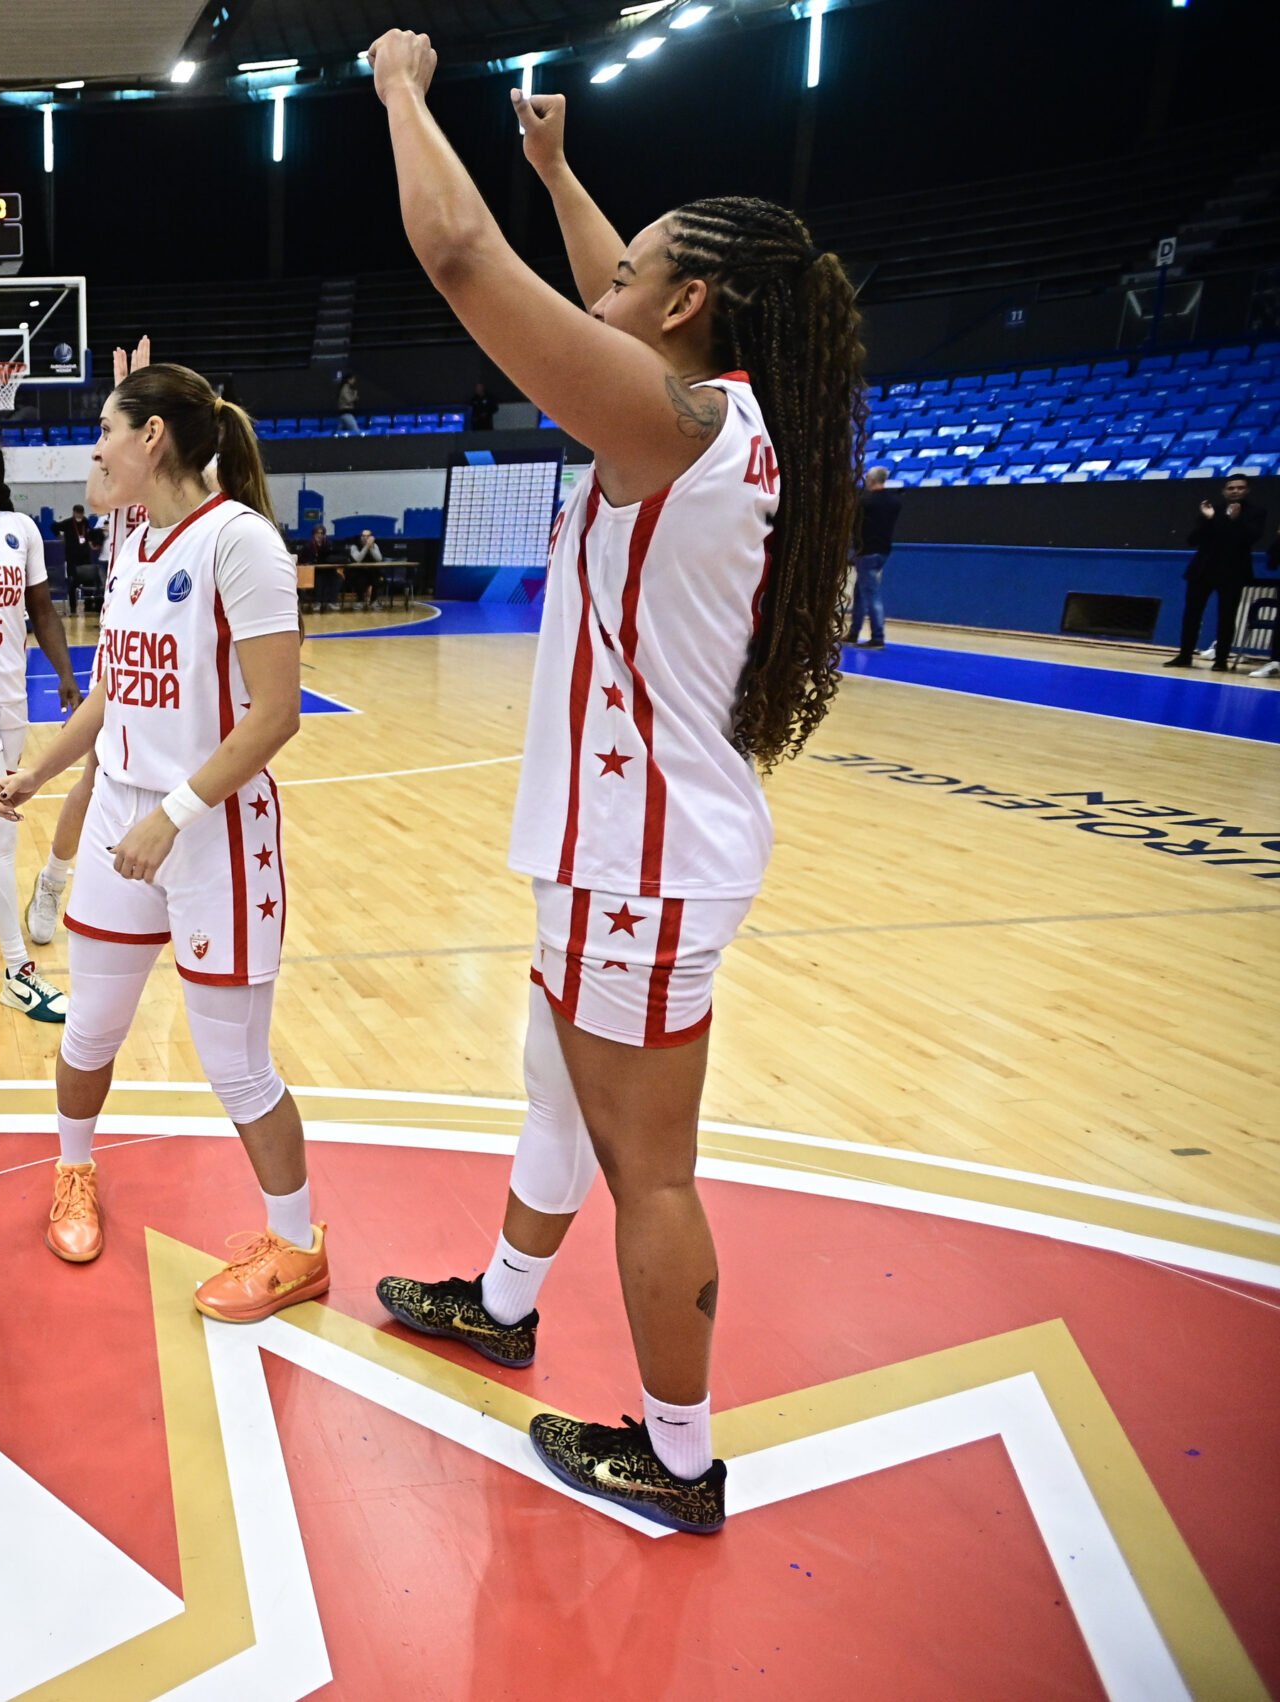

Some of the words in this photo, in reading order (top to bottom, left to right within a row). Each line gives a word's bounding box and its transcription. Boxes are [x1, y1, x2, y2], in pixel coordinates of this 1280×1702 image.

[1160, 242, 1173, 257] D
[104, 628, 179, 670] RVENA
[106, 667, 180, 709] VEZDA
